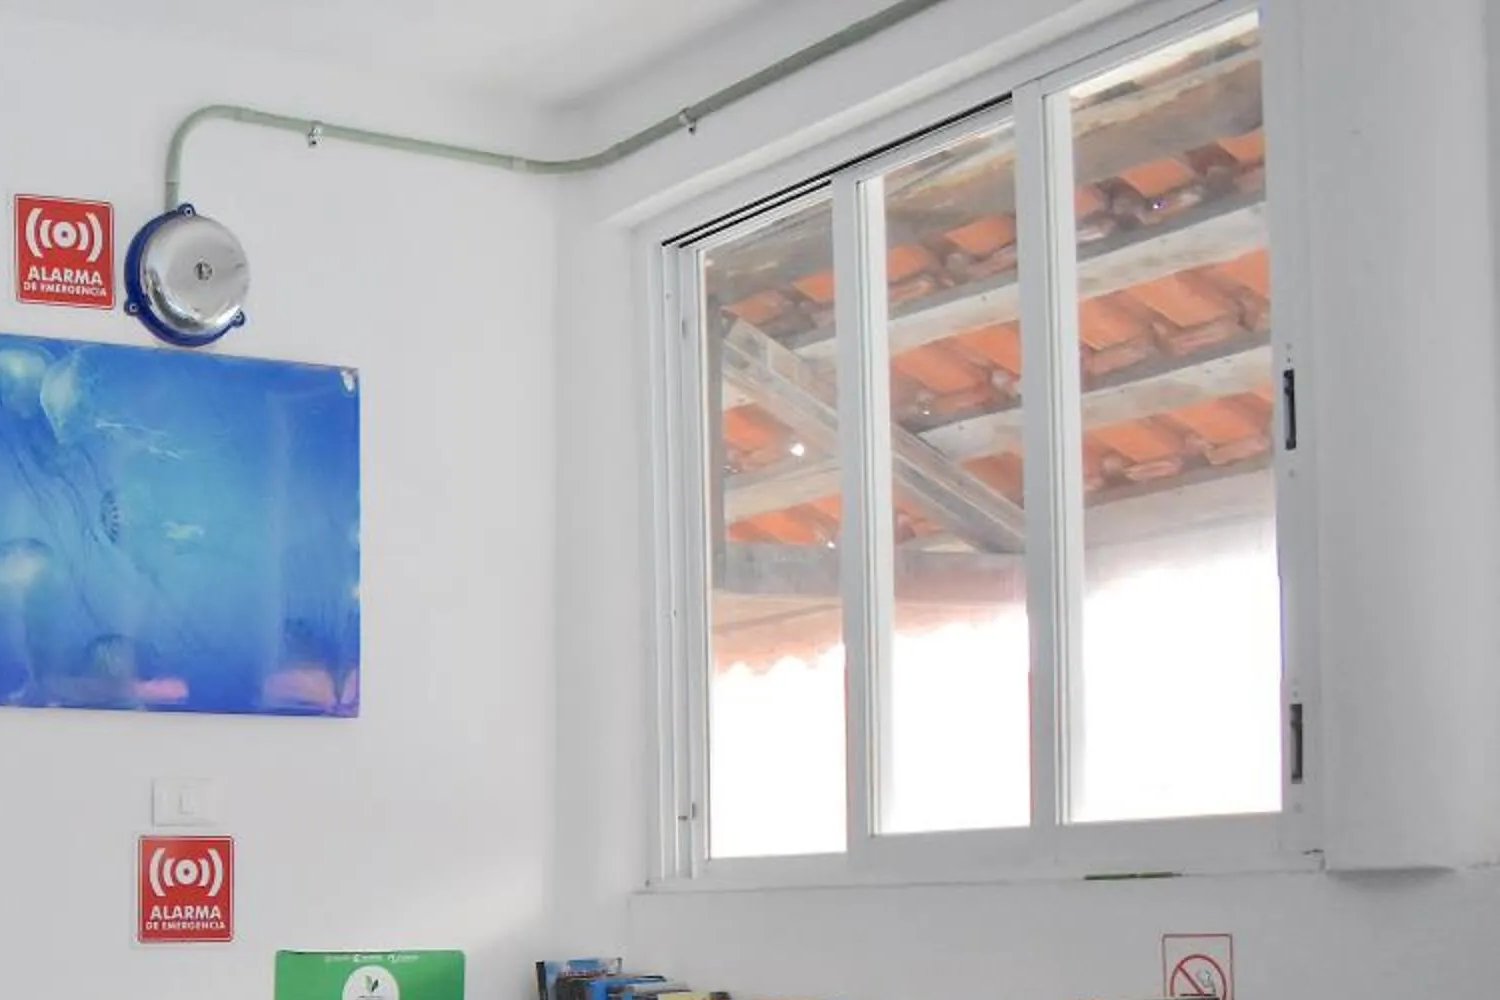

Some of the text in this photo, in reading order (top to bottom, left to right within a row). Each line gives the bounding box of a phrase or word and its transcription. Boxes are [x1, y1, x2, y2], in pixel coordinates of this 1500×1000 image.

[27, 265, 103, 286] ALARMA
[23, 281, 107, 296] DE EMERGENCIA
[150, 905, 221, 920] ALARMA
[145, 921, 226, 930] DE EMERGENCIA
